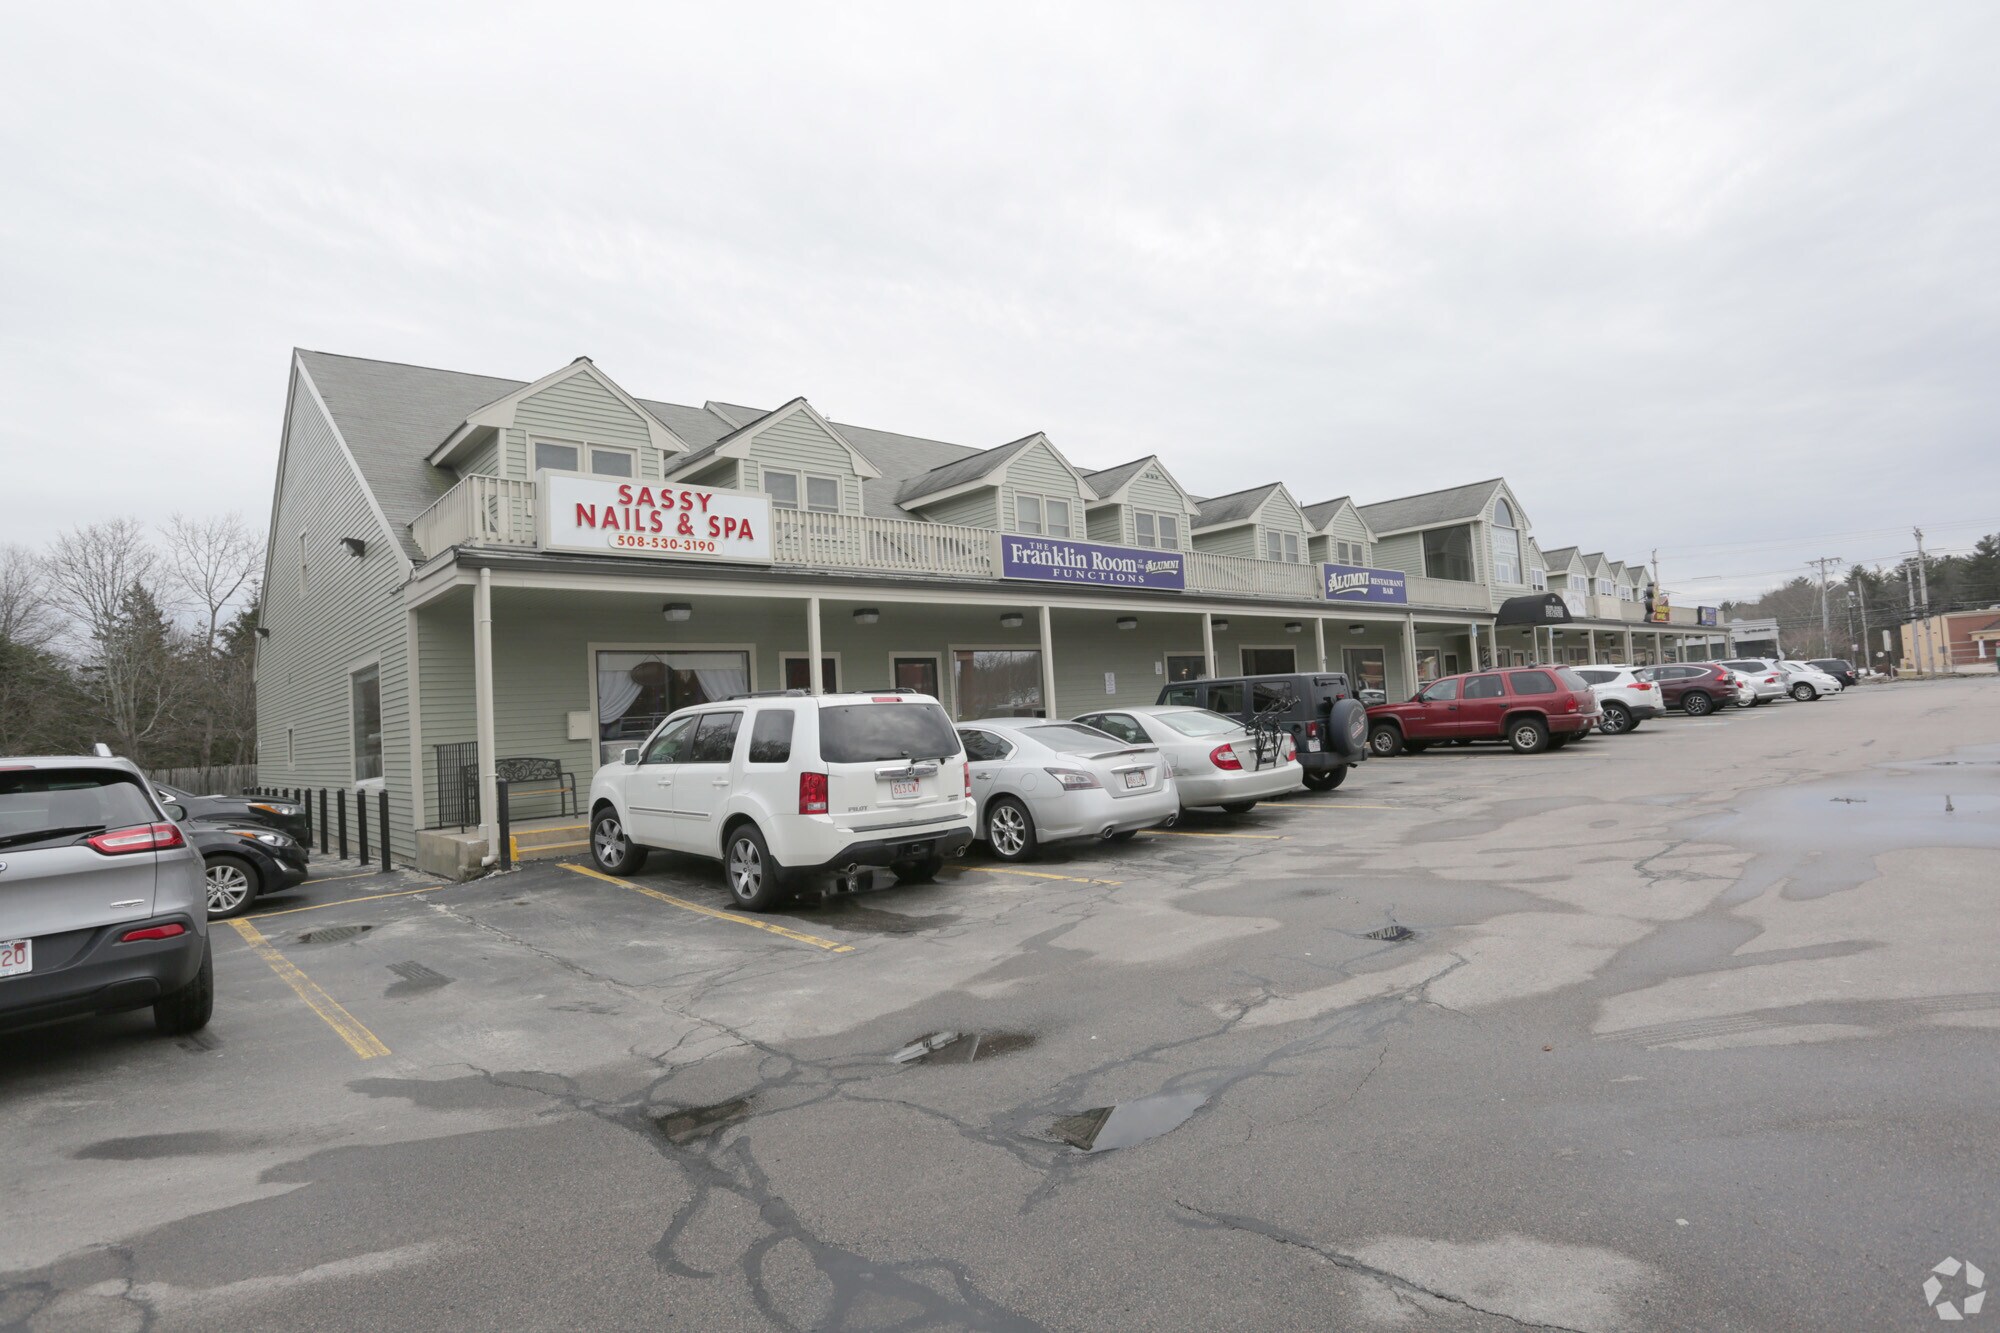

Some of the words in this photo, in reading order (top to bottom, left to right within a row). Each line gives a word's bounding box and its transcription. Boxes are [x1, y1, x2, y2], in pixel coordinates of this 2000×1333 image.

[618, 484, 713, 513] SASSY
[576, 502, 664, 533] NAILS
[677, 512, 695, 536] &
[708, 515, 754, 540] SPA
[617, 535, 715, 552] 508-530-3190
[1029, 541, 1049, 550] THE
[1010, 543, 1088, 569] Franklin
[1091, 551, 1138, 573] Room
[1145, 560, 1179, 573] ALUMNI
[1053, 568, 1145, 583] FUNCTIONS
[1328, 572, 1370, 592] ALUMNI
[1370, 577, 1403, 587] RESTAURANT
[1382, 587, 1394, 595] BAR
[894, 784, 907, 794] 613
[907, 783, 920, 793] CW7
[2, 947, 25, 967] 20
